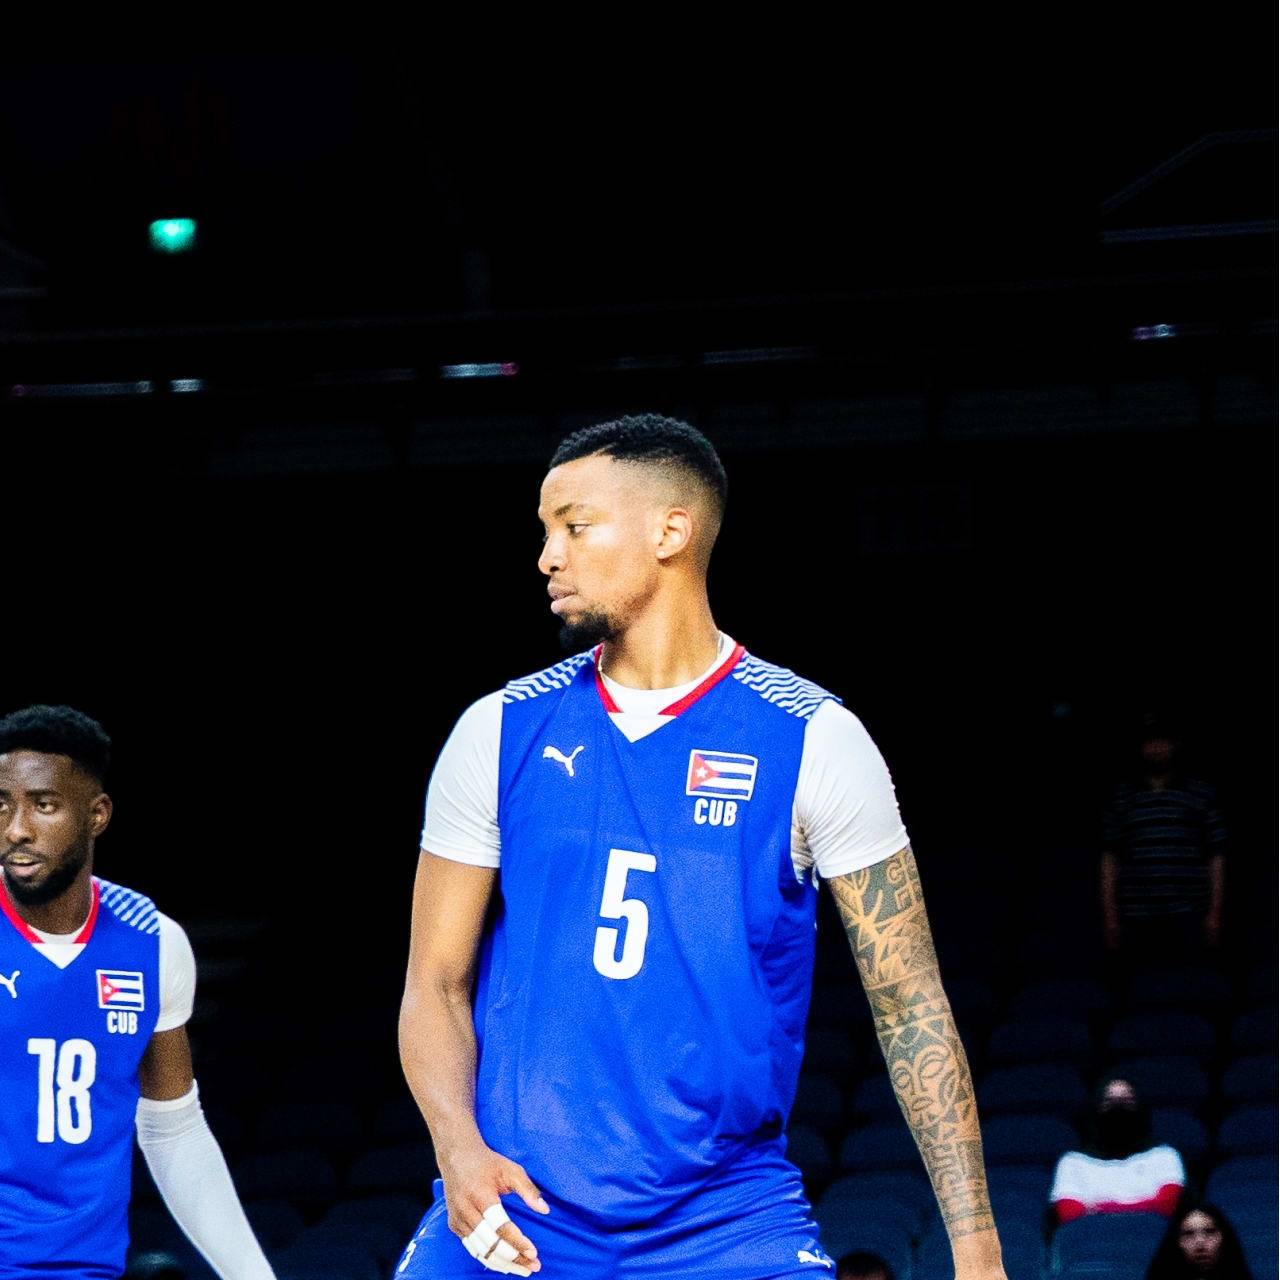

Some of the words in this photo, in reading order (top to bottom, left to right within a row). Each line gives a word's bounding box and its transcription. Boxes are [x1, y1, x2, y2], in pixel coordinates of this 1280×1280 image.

[693, 797, 738, 827] CUB
[593, 848, 657, 980] 5
[107, 1010, 138, 1035] CUB
[27, 1037, 97, 1145] 18
